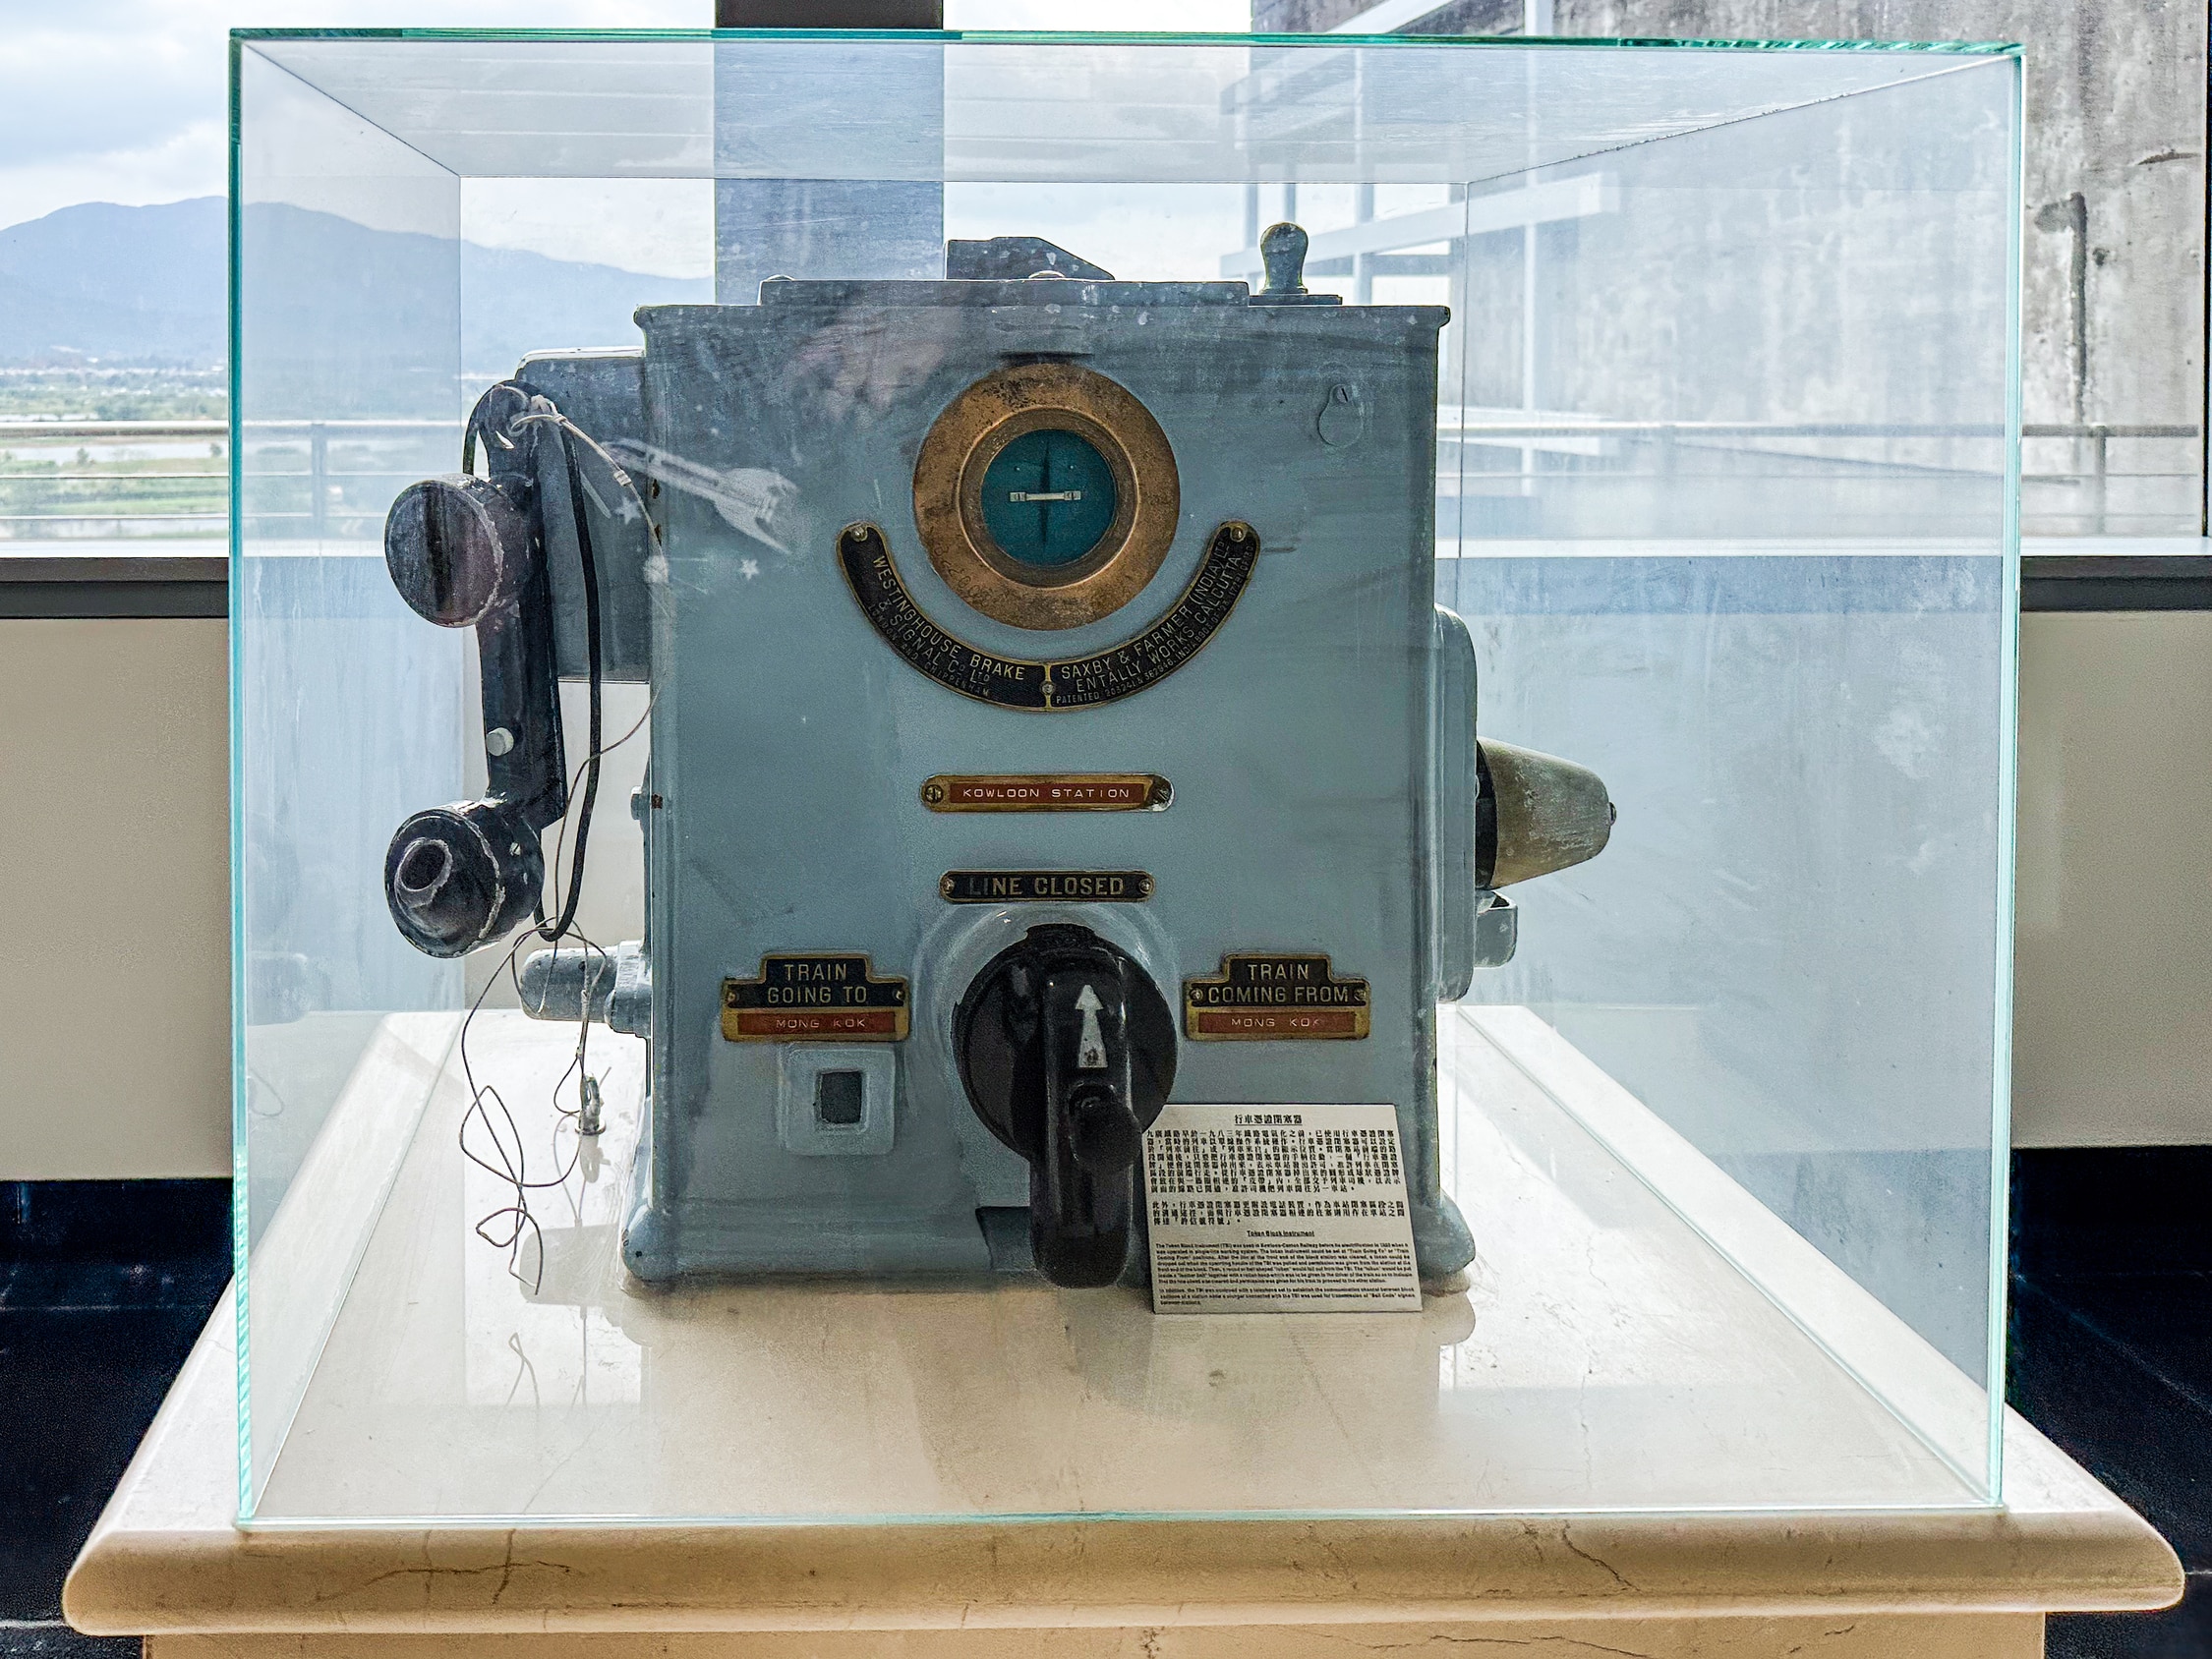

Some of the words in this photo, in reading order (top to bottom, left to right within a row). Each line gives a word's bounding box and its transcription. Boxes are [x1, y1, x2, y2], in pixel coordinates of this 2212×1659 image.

[872, 554, 962, 659] WESTINGHOUSE
[969, 654, 1025, 680] BRAKE
[1076, 659, 1141, 693] ENTALLY
[1147, 625, 1194, 664] WORKS
[1193, 556, 1242, 624] CALCUTTA
[878, 599, 894, 611] &
[889, 613, 942, 666] SIGNAL
[1061, 657, 1112, 679] SAXBY
[1117, 650, 1131, 664] &
[1133, 604, 1193, 657] FARMER
[1056, 691, 1100, 705] PATENTED
[961, 787, 1040, 798] KOWLOON
[1051, 787, 1130, 798] STATION
[968, 877, 1023, 896] LINE
[1034, 876, 1126, 896] CLOSED
[784, 963, 847, 981] TRAIN
[1247, 963, 1310, 981] TRAIN
[767, 986, 832, 1003] GOING
[843, 986, 867, 1003] TO
[1207, 986, 1287, 1003] COMING
[1294, 986, 1349, 1002] FROM
[775, 1018, 820, 1029] MONG
[833, 1018, 866, 1028] KOK
[1230, 1018, 1276, 1028] MONG
